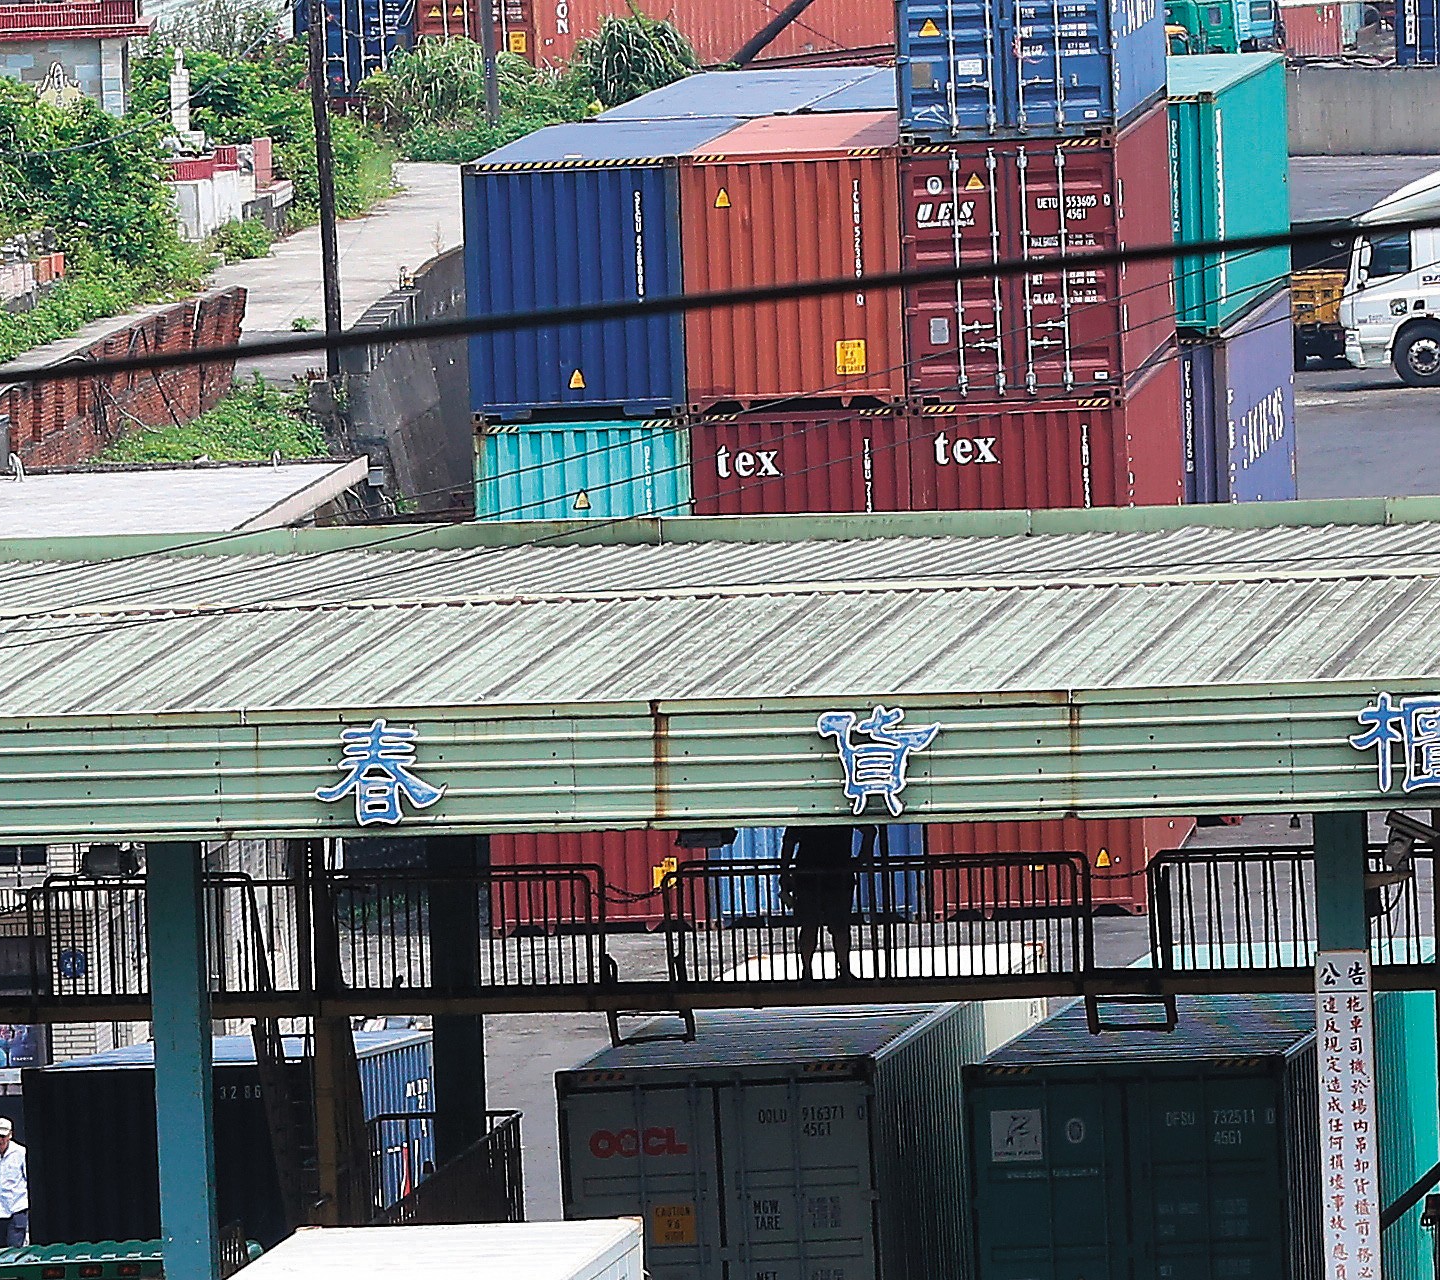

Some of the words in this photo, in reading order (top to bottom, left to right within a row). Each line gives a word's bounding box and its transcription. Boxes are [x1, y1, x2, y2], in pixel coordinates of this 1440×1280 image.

[717, 445, 782, 477] tex
[934, 431, 1000, 465] tex
[1320, 961, 1367, 986] 公告
[589, 1126, 688, 1158] OOCL
